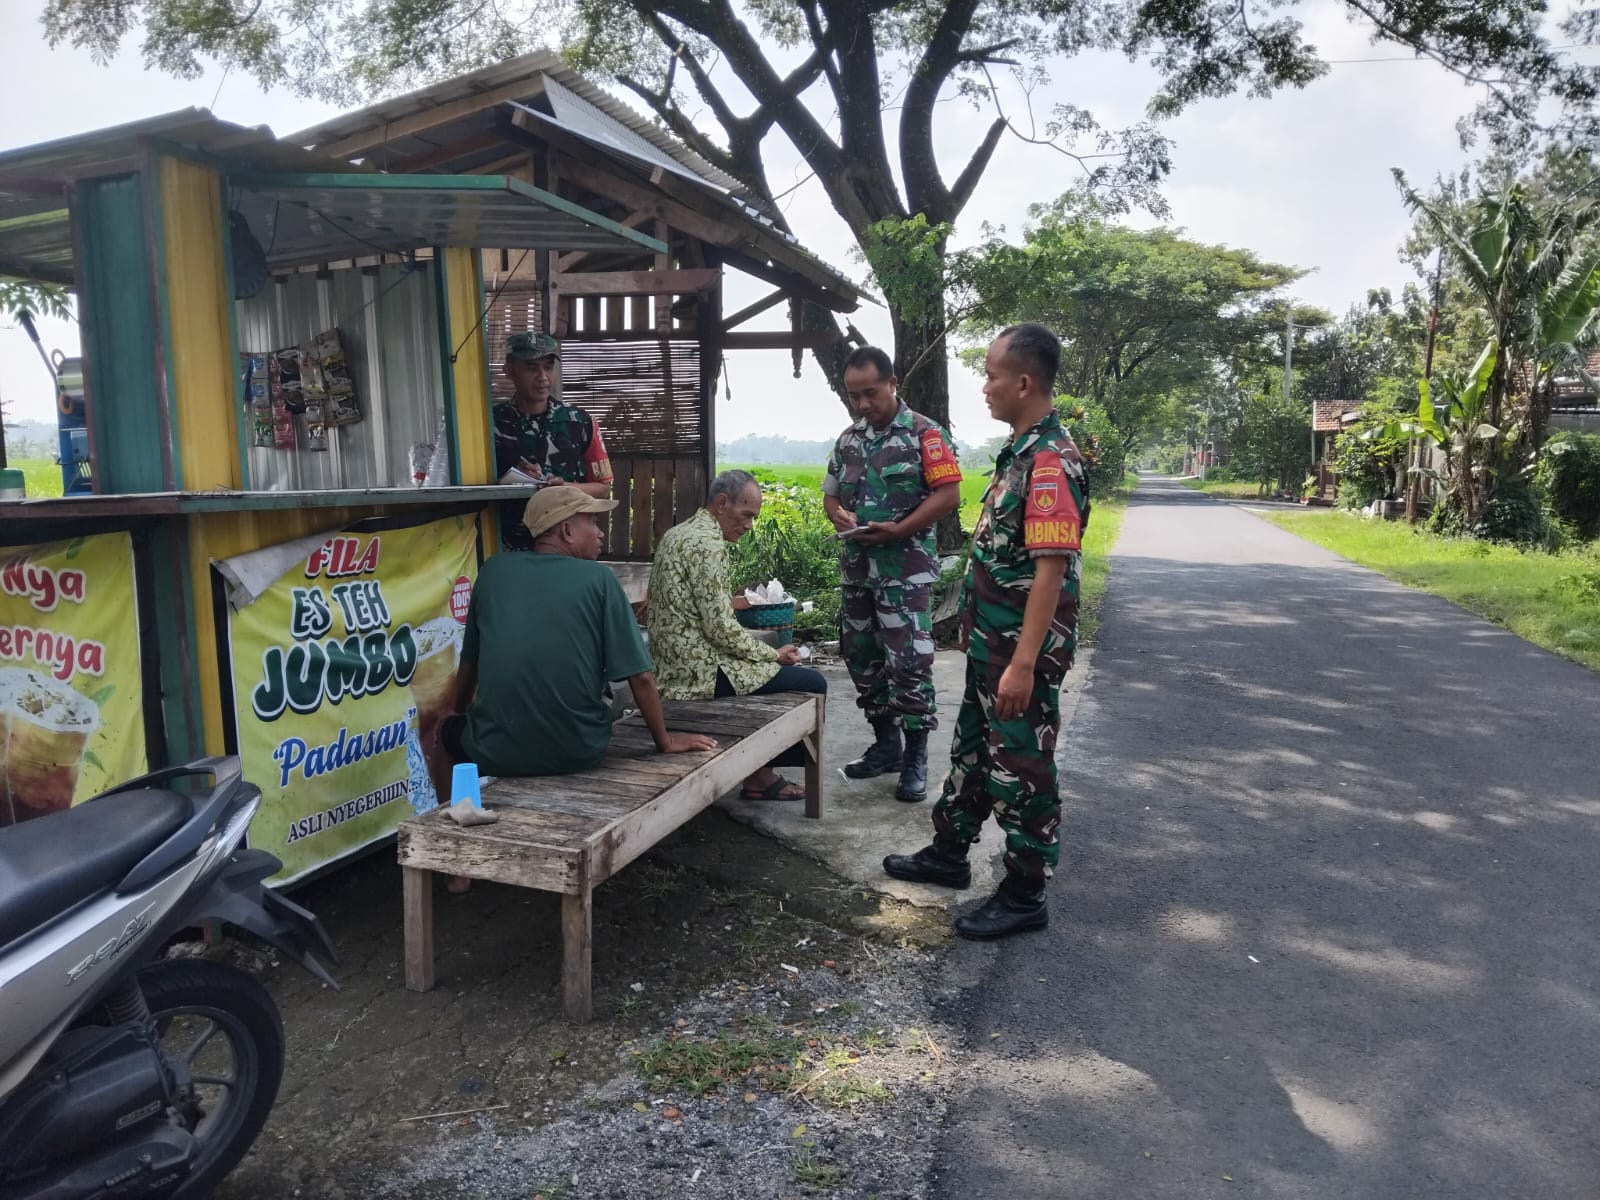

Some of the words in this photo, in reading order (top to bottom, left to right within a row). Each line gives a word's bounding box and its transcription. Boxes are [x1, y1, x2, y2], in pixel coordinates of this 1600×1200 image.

[304, 536, 380, 578] FILA
[291, 587, 332, 640] ES
[331, 579, 392, 633] TEH
[252, 623, 419, 720] JUMBO
[287, 813, 323, 843] ASLI
